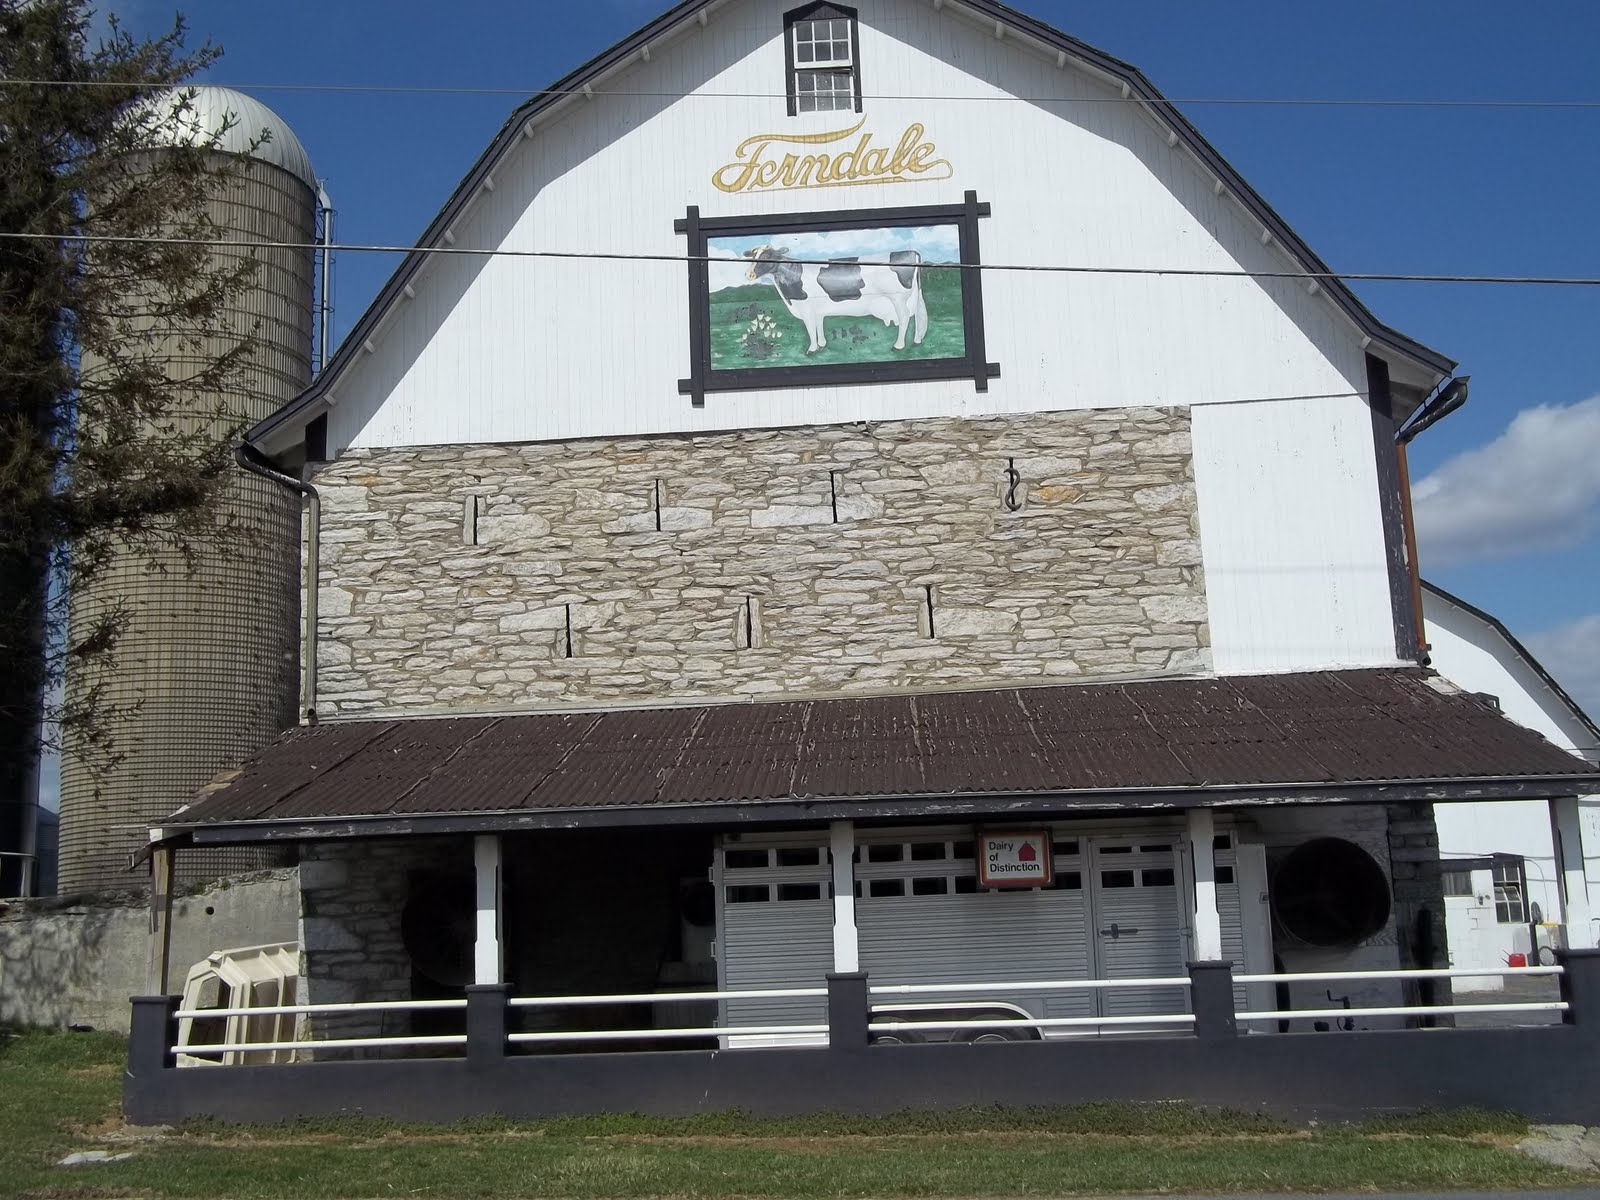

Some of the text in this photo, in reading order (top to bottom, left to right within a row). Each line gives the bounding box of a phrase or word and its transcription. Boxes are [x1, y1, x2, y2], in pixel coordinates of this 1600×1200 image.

[712, 113, 953, 194] Ferndale
[989, 841, 1014, 852] Dairy
[989, 853, 999, 861] of
[990, 863, 1040, 872] Distinction
